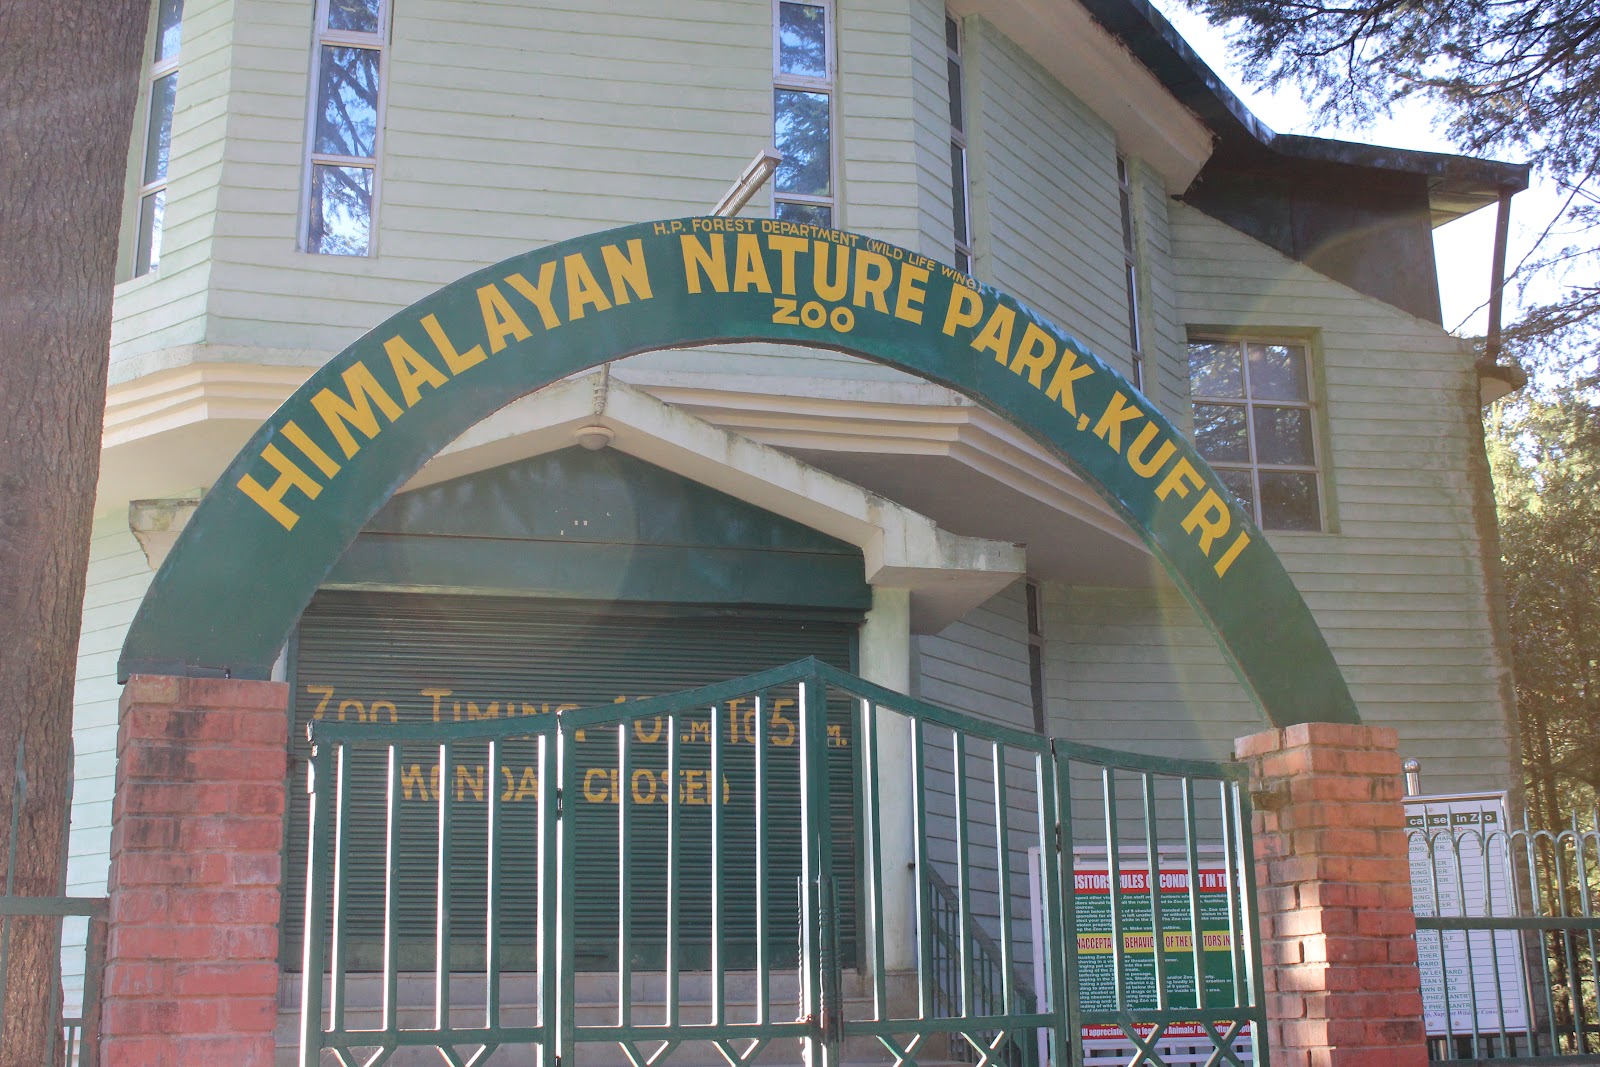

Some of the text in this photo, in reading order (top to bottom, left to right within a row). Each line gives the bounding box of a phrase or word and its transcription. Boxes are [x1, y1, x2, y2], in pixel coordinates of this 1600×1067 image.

[654, 222, 686, 235] H.P.
[692, 219, 754, 232] FOREST
[762, 221, 859, 247] DEPARTMENT
[867, 238, 903, 260] (WILD
[909, 253, 935, 271] LIFE
[772, 298, 855, 333] ZOO
[236, 233, 1252, 579] HIMALAYAN NATURE PARK, KUFRI
[401, 764, 539, 801] MONDA
[1433, 816, 1447, 824] se
[1456, 814, 1467, 823] in
[1470, 813, 1493, 822] Zo
[1074, 875, 1110, 889] ISITORS
[1160, 873, 1204, 888] CONDT
[1206, 873, 1218, 887] IN
[1077, 936, 1113, 950] NACCEPTA
[1125, 936, 1154, 949] BEHAVIO
[1166, 937, 1175, 948] OF
[1176, 936, 1188, 947] THE
